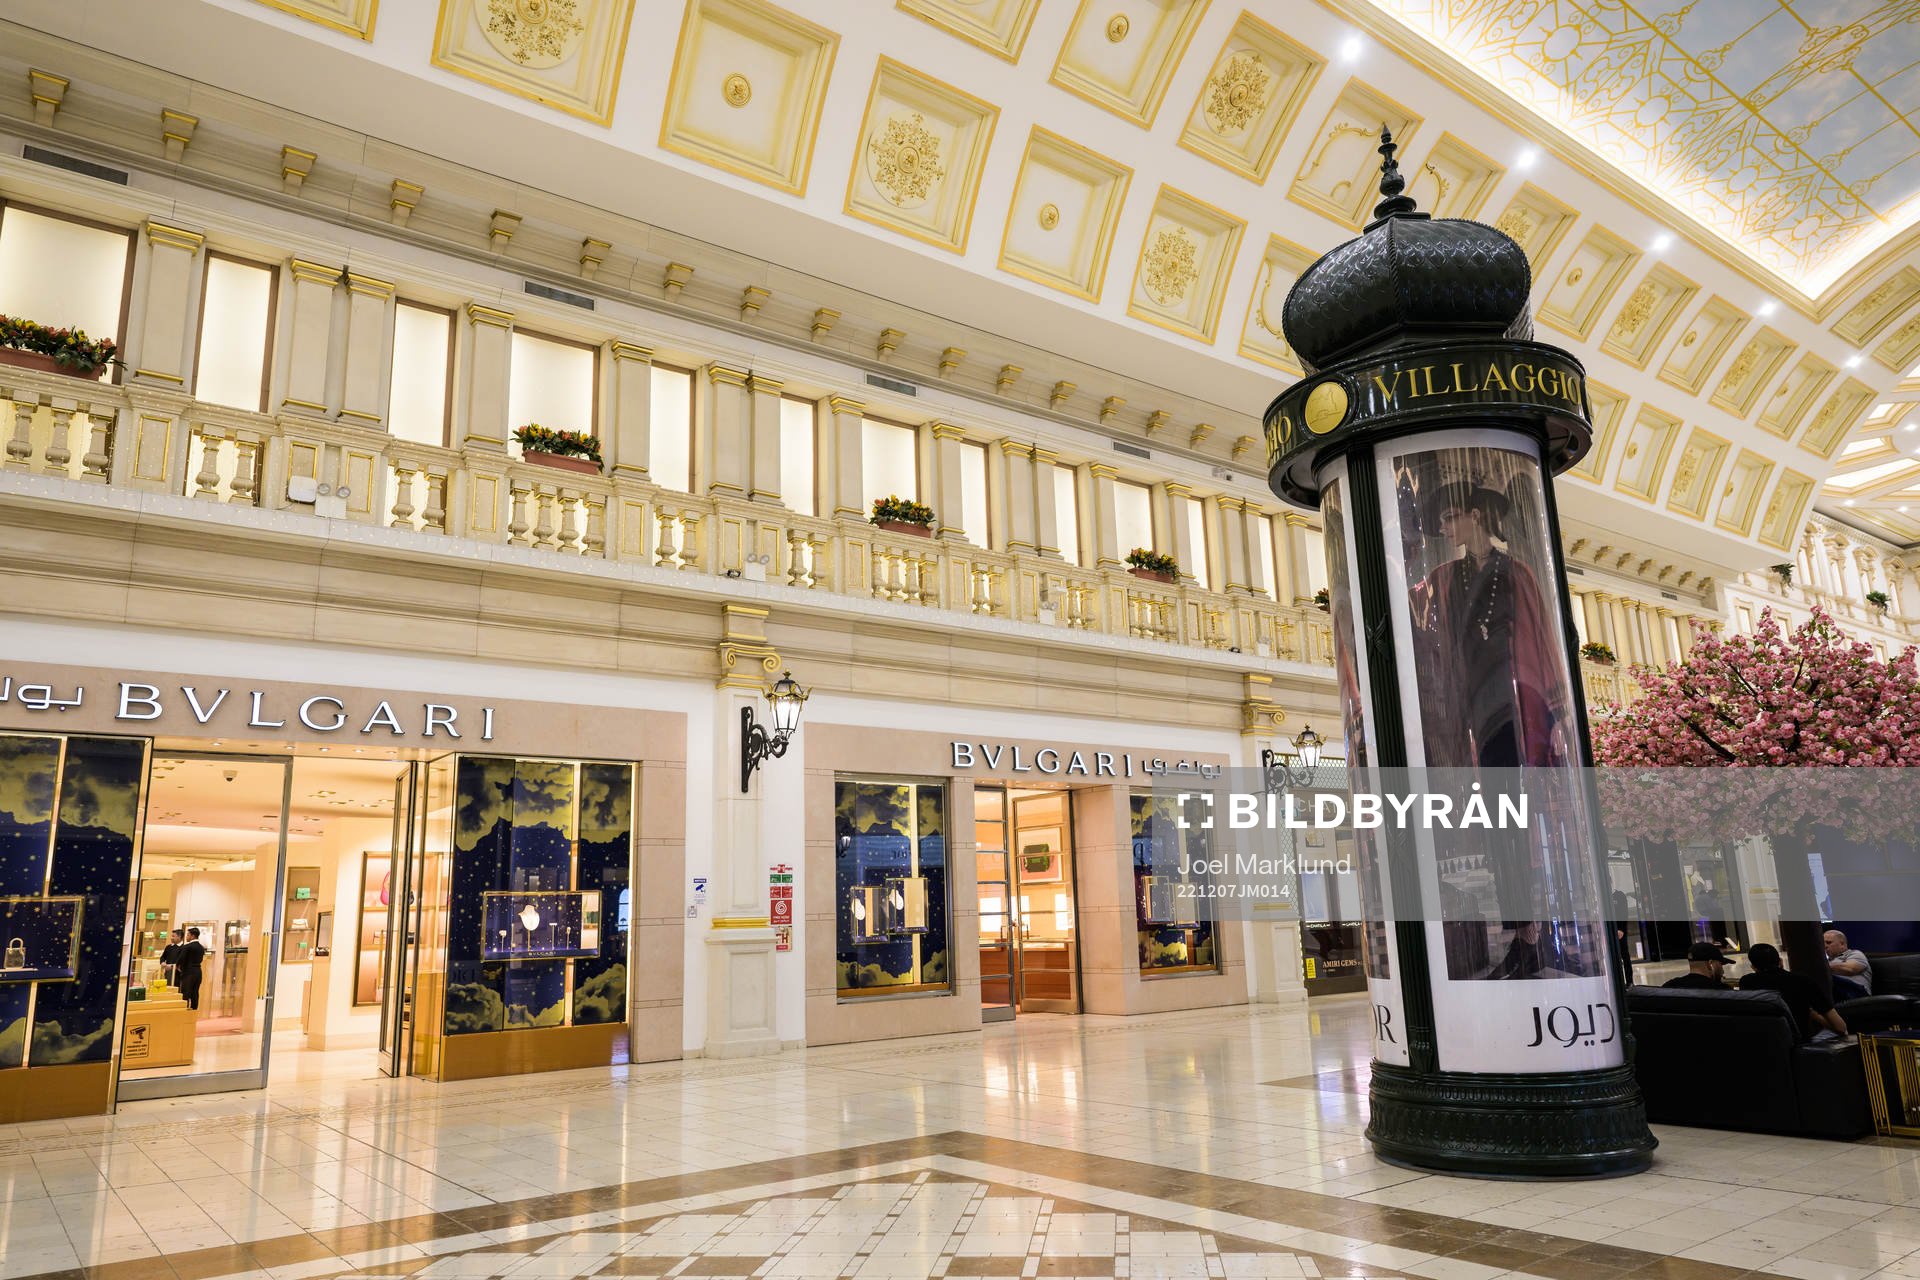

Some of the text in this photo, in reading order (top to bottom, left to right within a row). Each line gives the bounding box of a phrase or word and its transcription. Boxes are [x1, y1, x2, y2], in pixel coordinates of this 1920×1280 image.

[1373, 362, 1582, 406] VILLAGGIO
[115, 682, 496, 741] BVLGARI
[951, 741, 1133, 778] BVLGARI
[1527, 1002, 1615, 1048] ديور
